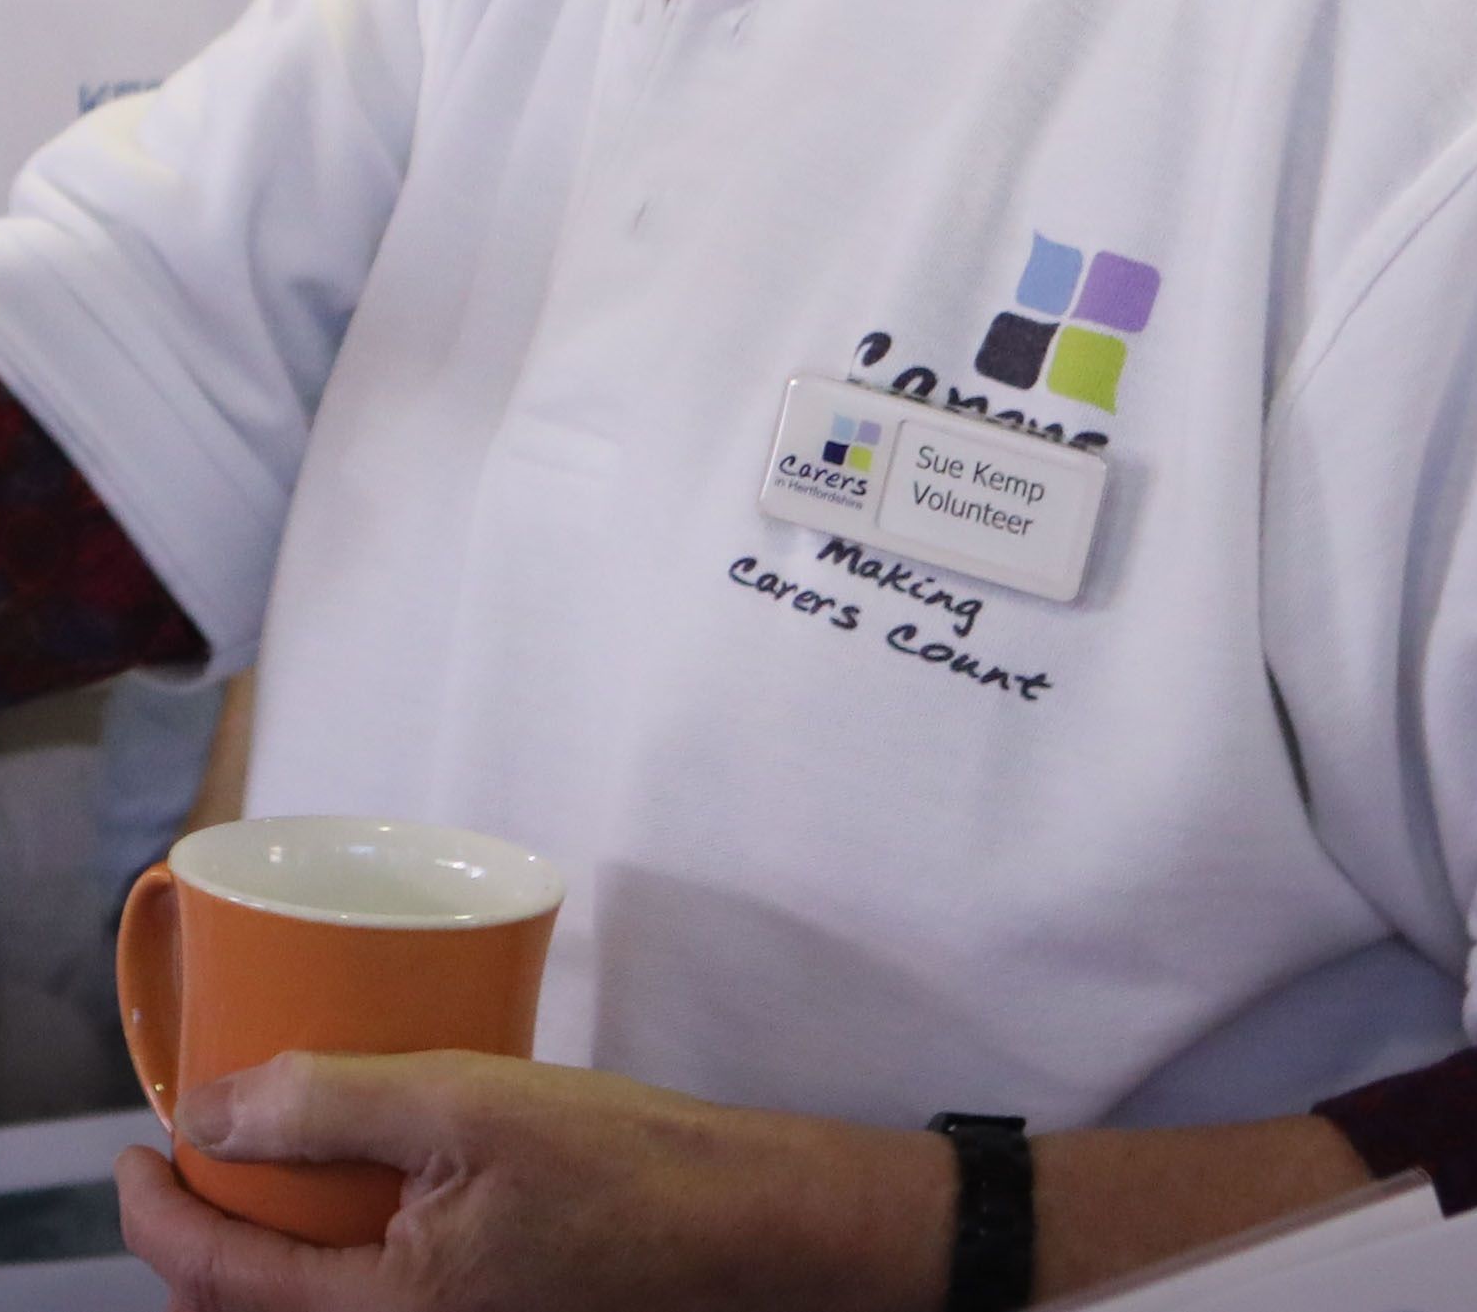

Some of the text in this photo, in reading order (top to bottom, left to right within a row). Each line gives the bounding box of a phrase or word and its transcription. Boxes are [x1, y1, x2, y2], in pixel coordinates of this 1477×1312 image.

[779, 454, 868, 497] Carers
[915, 445, 1045, 505] Sue Kemp
[913, 481, 1034, 536] Volunteer
[816, 536, 984, 637] Making
[728, 555, 1052, 702] Carers Count
